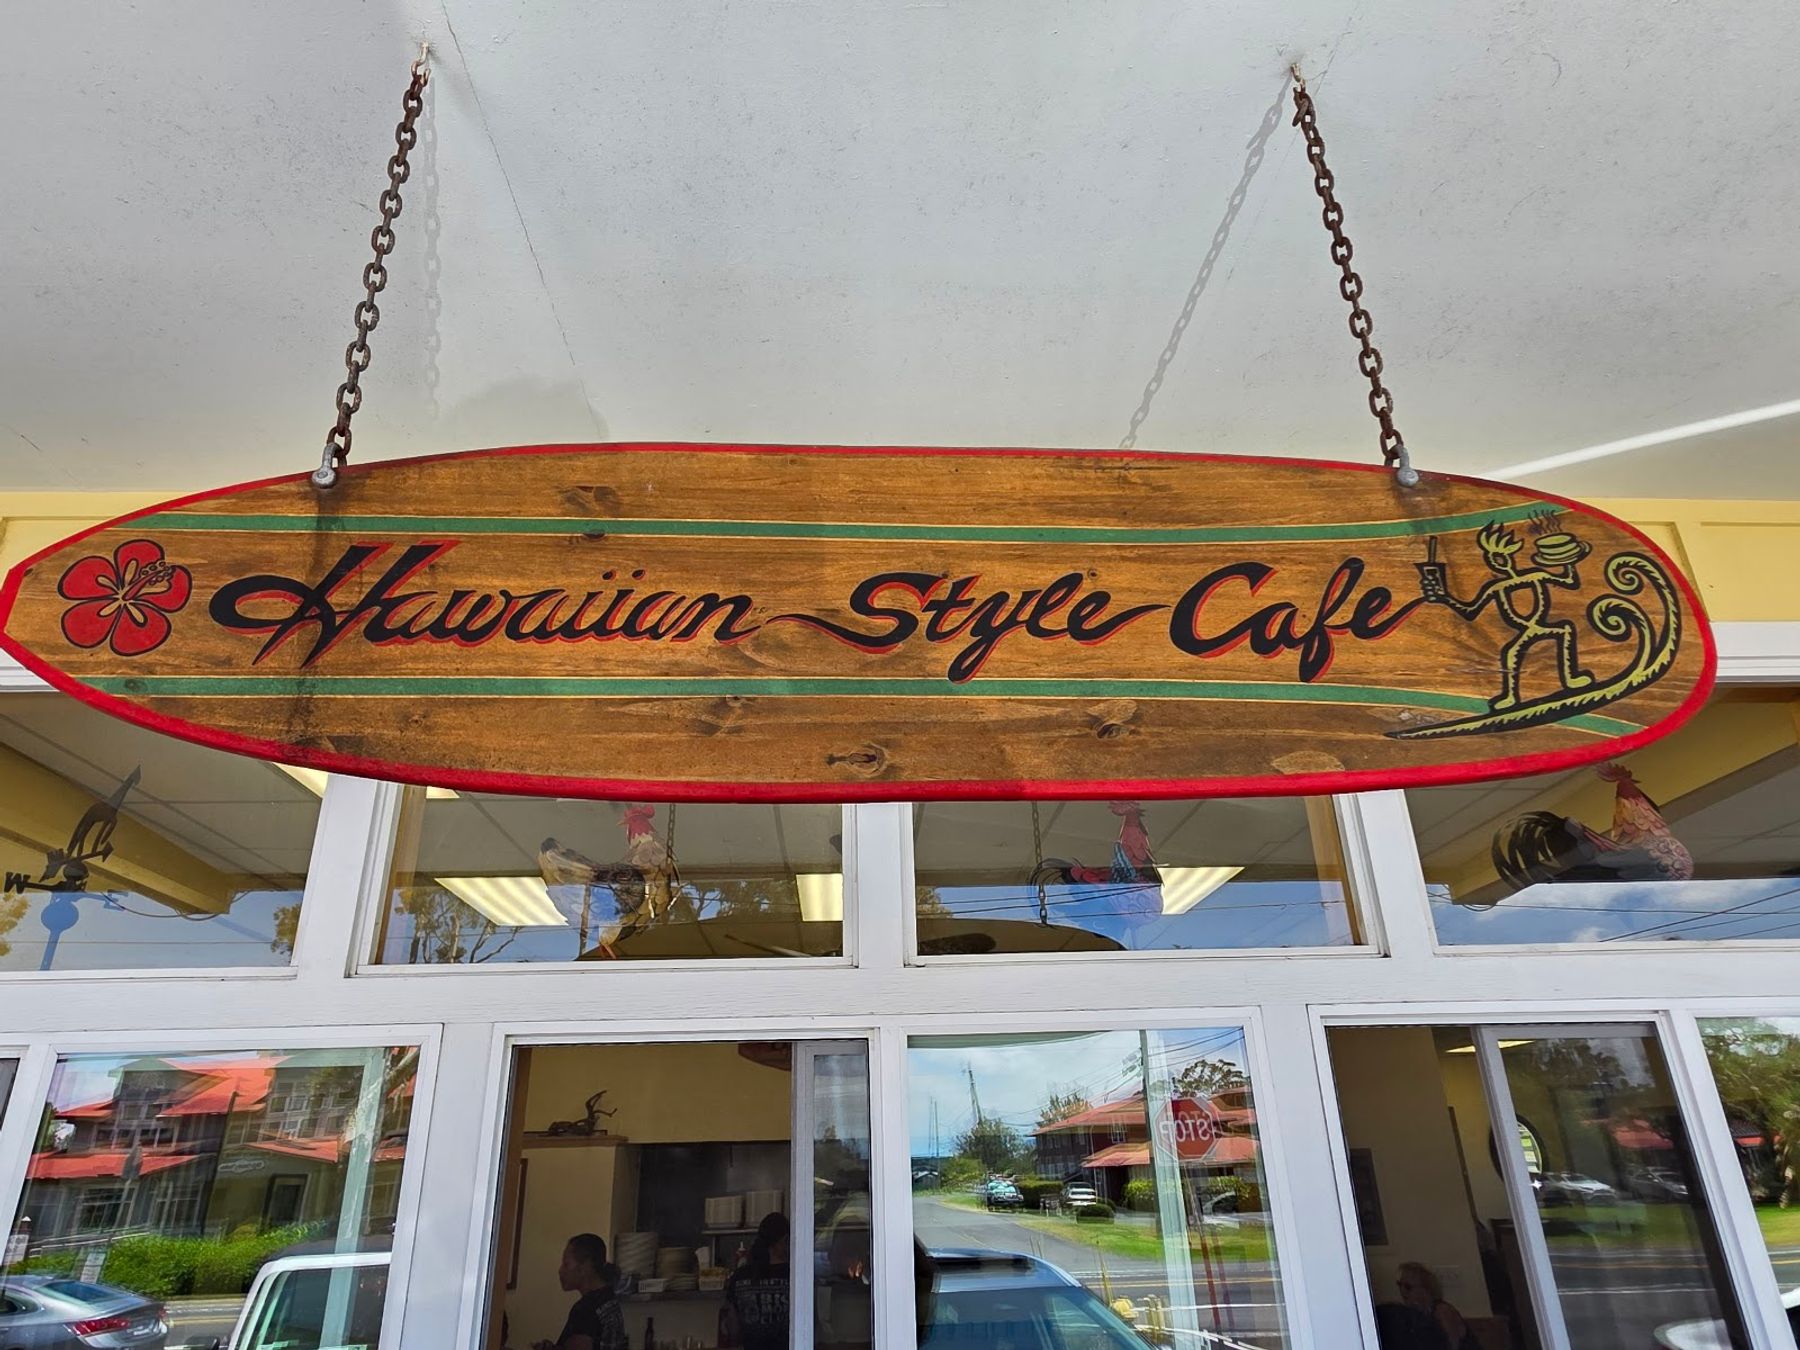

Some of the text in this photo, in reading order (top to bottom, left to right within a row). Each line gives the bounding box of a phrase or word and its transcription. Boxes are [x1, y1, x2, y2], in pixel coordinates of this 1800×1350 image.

[208, 540, 1431, 684] Hawaiian Style Cafe
